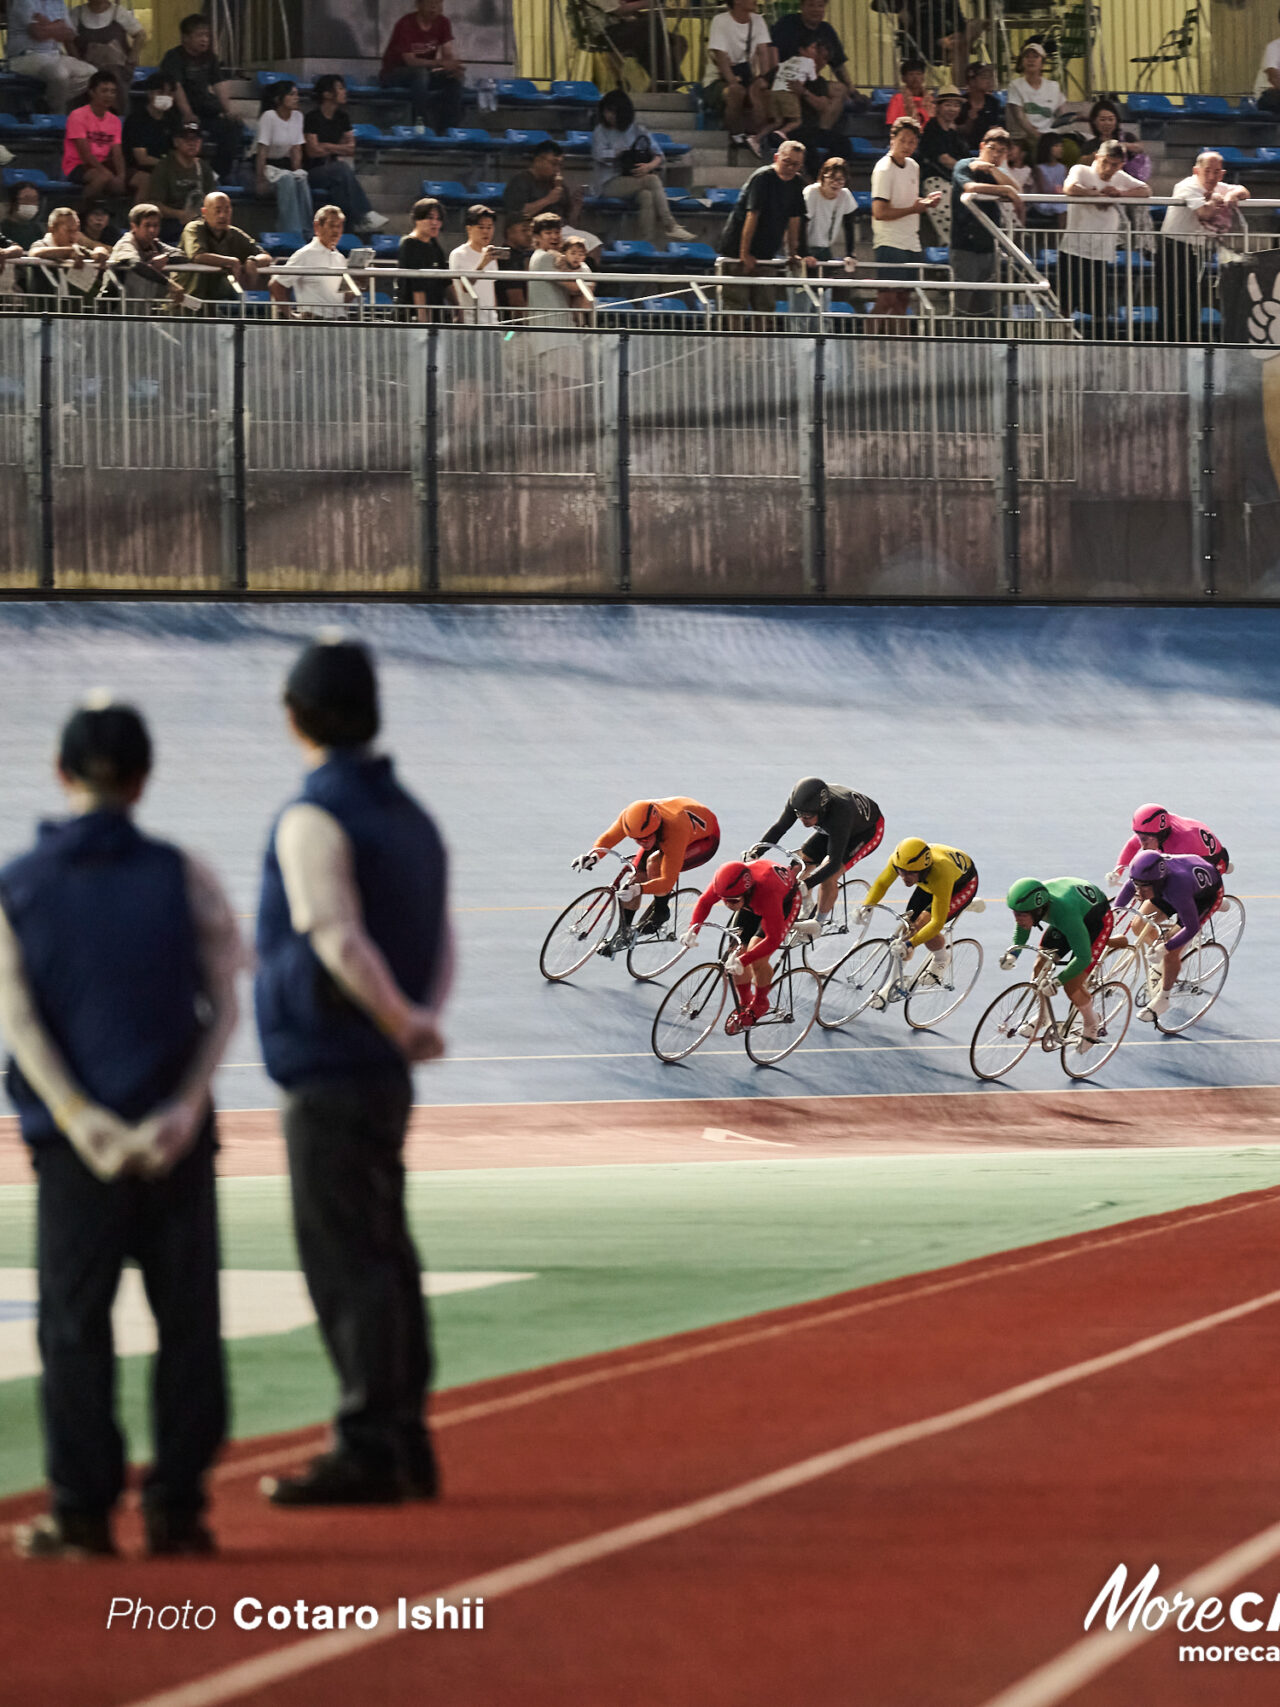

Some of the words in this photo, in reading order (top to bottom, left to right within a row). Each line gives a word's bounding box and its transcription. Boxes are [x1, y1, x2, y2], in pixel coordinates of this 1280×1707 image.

[1159, 813, 1167, 829] 8
[1199, 828, 1216, 856] 8
[1192, 866, 1212, 888] 9
[1034, 891, 1043, 907] 6
[1074, 884, 1099, 906] 6
